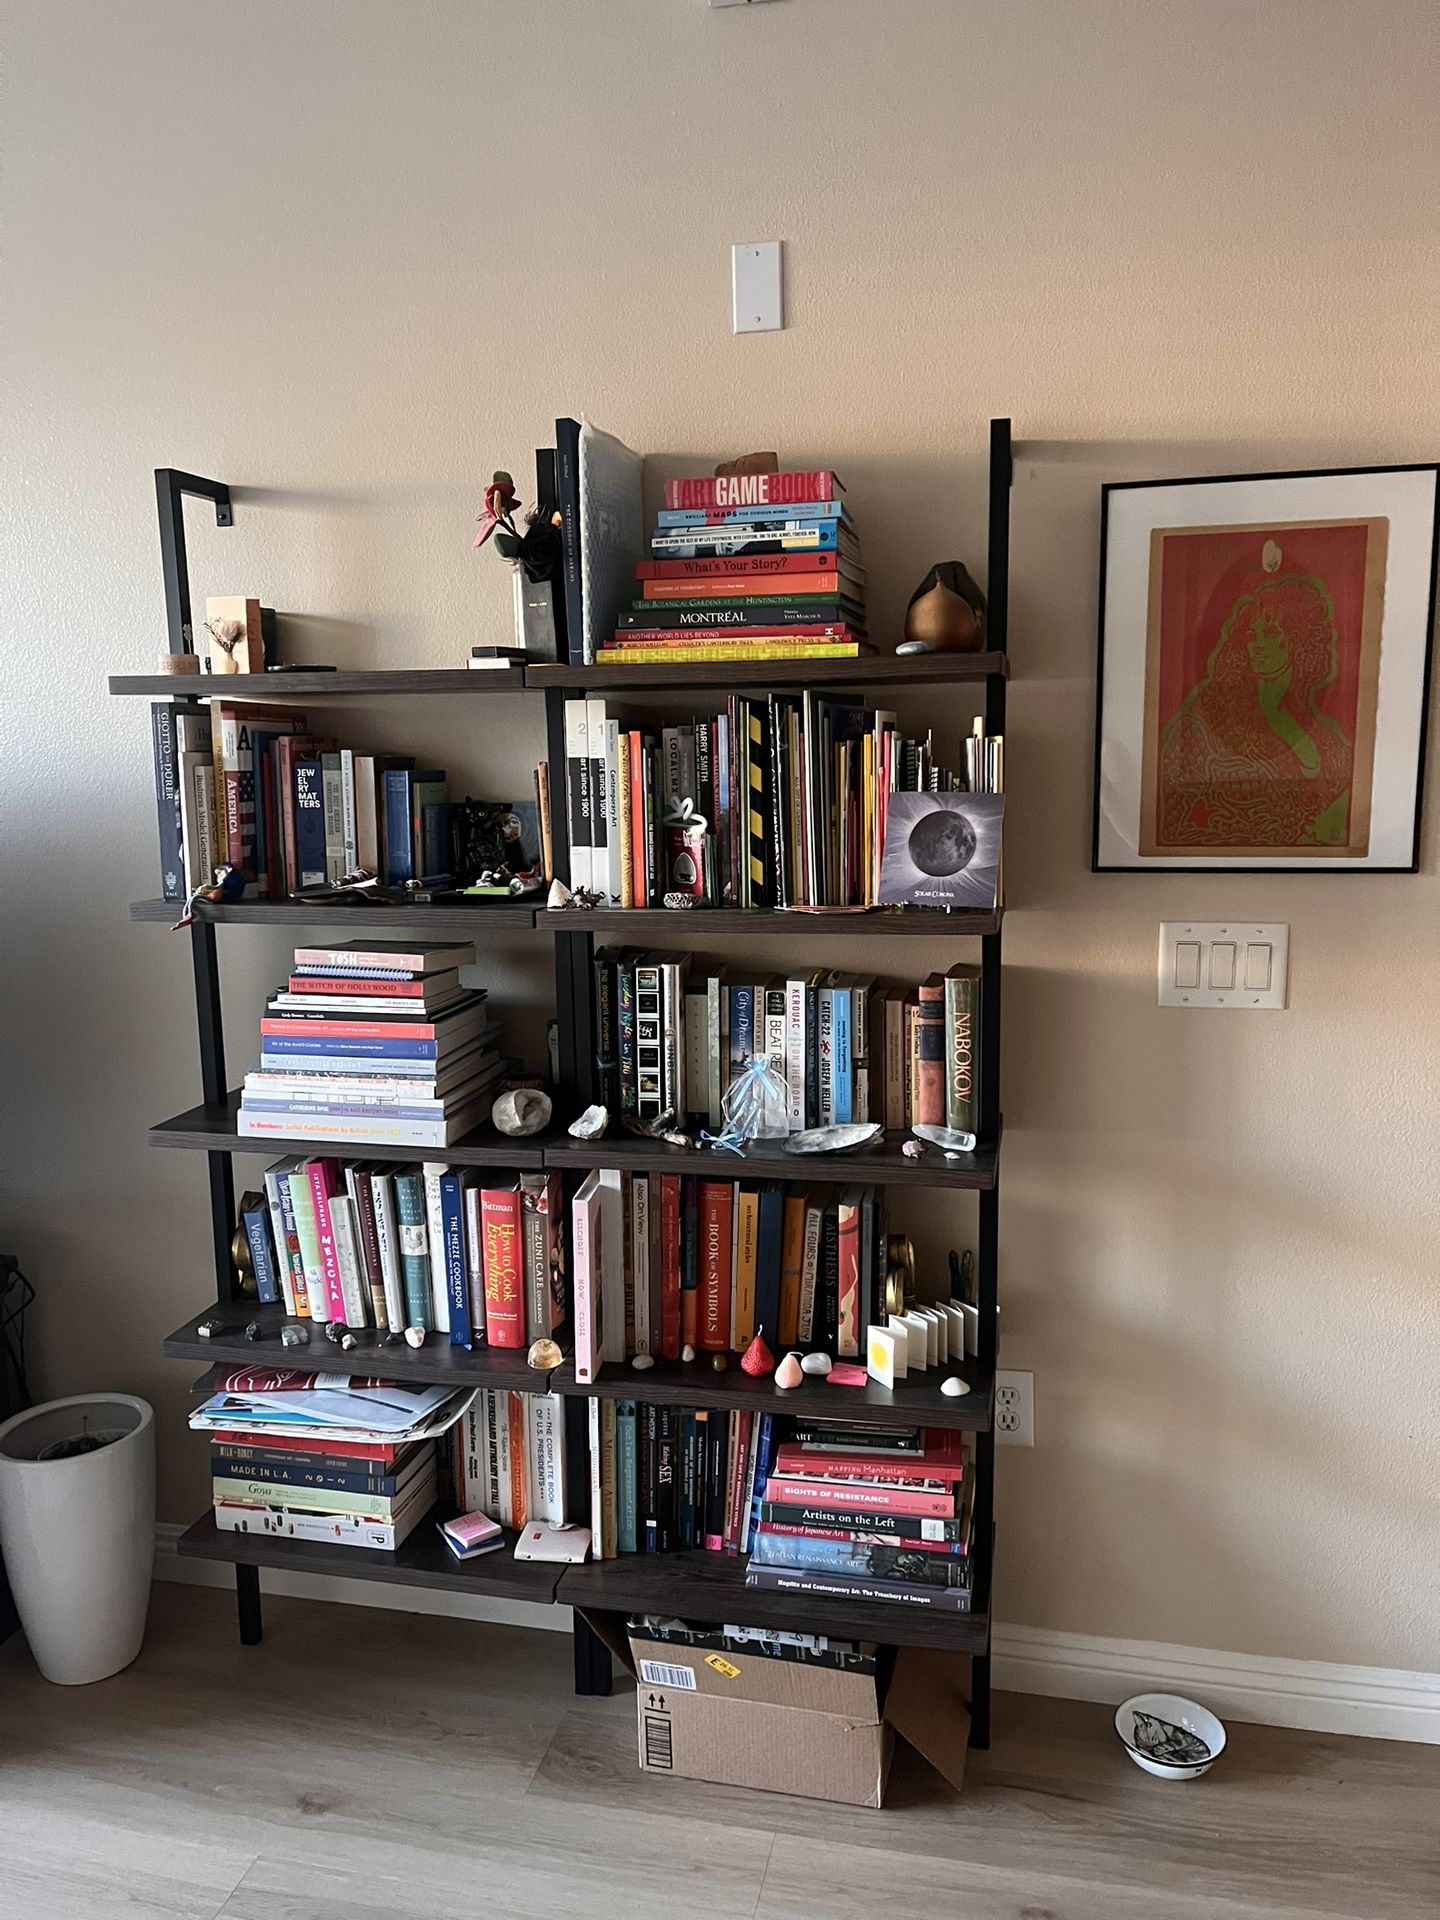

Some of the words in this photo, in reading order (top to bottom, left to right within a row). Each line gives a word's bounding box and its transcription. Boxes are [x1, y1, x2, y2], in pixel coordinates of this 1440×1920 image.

[715, 474, 769, 507] GAME
[769, 472, 820, 503] BOOK
[713, 510, 738, 519] MAPS
[684, 560, 720, 573] What's
[723, 560, 749, 571] Your
[751, 557, 788, 571] Story?
[638, 600, 651, 608] THE
[652, 599, 687, 608] BOTANICAL
[689, 598, 721, 607] GARDENS
[746, 596, 792, 605] HUNTINGTON
[680, 610, 747, 624] MONTRÉAL
[627, 632, 656, 640] ANOTHER
[657, 631, 680, 639] WORLD
[160, 711, 172, 754] GIOTTO
[578, 723, 587, 734] 2
[297, 768, 316, 778] JEW
[580, 757, 588, 771] art
[598, 758, 606, 772] art
[669, 737, 679, 794] LOCAL.MX
[196, 774, 206, 809] Business
[297, 777, 308, 785] EL
[298, 784, 310, 793] RY
[580, 772, 589, 795] since
[599, 774, 607, 796] since
[299, 792, 317, 801] MAT
[609, 769, 617, 815] Contemporary
[227, 779, 238, 834] AMERICA
[299, 800, 321, 808] TERS
[581, 797, 590, 817] 1900
[198, 810, 208, 837] Model
[200, 839, 210, 880] Generation
[931, 890, 955, 898] CORONA
[328, 953, 357, 966] TOSH
[292, 981, 307, 989] THE
[308, 982, 333, 990] WITCH
[347, 984, 397, 992] HOLLYWOOD
[619, 972, 633, 1009] Tuesday
[736, 991, 749, 1011] City
[791, 988, 801, 1029] KEROUAC
[821, 1000, 831, 1036] CATCH-22
[770, 1020, 782, 1051] BEAT
[624, 1043, 633, 1054] in
[953, 1012, 972, 1104] NABOKOV
[791, 1064, 801, 1080] THE
[821, 1057, 831, 1085] JOSEPH
[791, 1083, 801, 1106] ROAD
[821, 1087, 831, 1113] HELLER
[637, 1183, 645, 1201] Also
[482, 1201, 513, 1212] Bittman
[637, 1201, 645, 1215] On
[450, 1216, 458, 1232] THE
[637, 1215, 645, 1236] View
[809, 1213, 819, 1230] ALL
[315, 1191, 327, 1228] BELFRAGE
[321, 1235, 340, 1301] MEZCLA
[452, 1233, 460, 1259] MEZZE
[501, 1223, 515, 1255] How
[535, 1234, 543, 1260] ZUNI
[708, 1223, 719, 1260] BOOK
[806, 1231, 818, 1260] FOURS
[250, 1223, 268, 1283] Vegetarian
[484, 1222, 503, 1304] Everything
[502, 1255, 512, 1267] to
[825, 1222, 837, 1286] AISTHESIS
[710, 1261, 716, 1270] OF
[453, 1261, 463, 1310] COOKBOOK
[502, 1268, 517, 1302] Cook
[802, 1271, 815, 1314] MIRANDA
[707, 1271, 719, 1332] SYMBOLS
[800, 1315, 811, 1340] JULY
[536, 1408, 543, 1420] OF
[489, 1440, 498, 1478] ANTHOLOGY
[537, 1438, 545, 1487] PRESIDENTS
[546, 1437, 554, 1479] COMPLETE
[230, 1464, 257, 1475] MADE
[260, 1467, 270, 1477] IN
[273, 1469, 293, 1480] L.A.
[659, 1465, 672, 1484] SEX
[828, 1465, 861, 1473] MAPPING
[862, 1464, 907, 1475] Manhattan
[248, 1483, 272, 1496] Goya
[547, 1481, 555, 1504] BOOK
[624, 1459, 634, 1530] Representation
[784, 1487, 817, 1496] SIGHTS
[834, 1492, 890, 1503] RESISTANCE
[802, 1508, 836, 1521] Artists
[855, 1514, 871, 1525] the
[875, 1516, 896, 1528] Left
[772, 1522, 797, 1534] History
[797, 1525, 804, 1533] of
[804, 1527, 833, 1537] Japanese
[833, 1529, 844, 1537] Art
[767, 1550, 796, 1561] ITALIAN
[797, 1554, 843, 1565] RENAISSANCE
[846, 1560, 860, 1568] ART
[777, 1579, 801, 1589] Magritte
[801, 1581, 812, 1590] and
[812, 1583, 850, 1595] Contemporary
[861, 1589, 874, 1597] The
[874, 1591, 902, 1601] Treachery
[909, 1595, 931, 1604] Images
[710, 1657, 720, 1666] E
